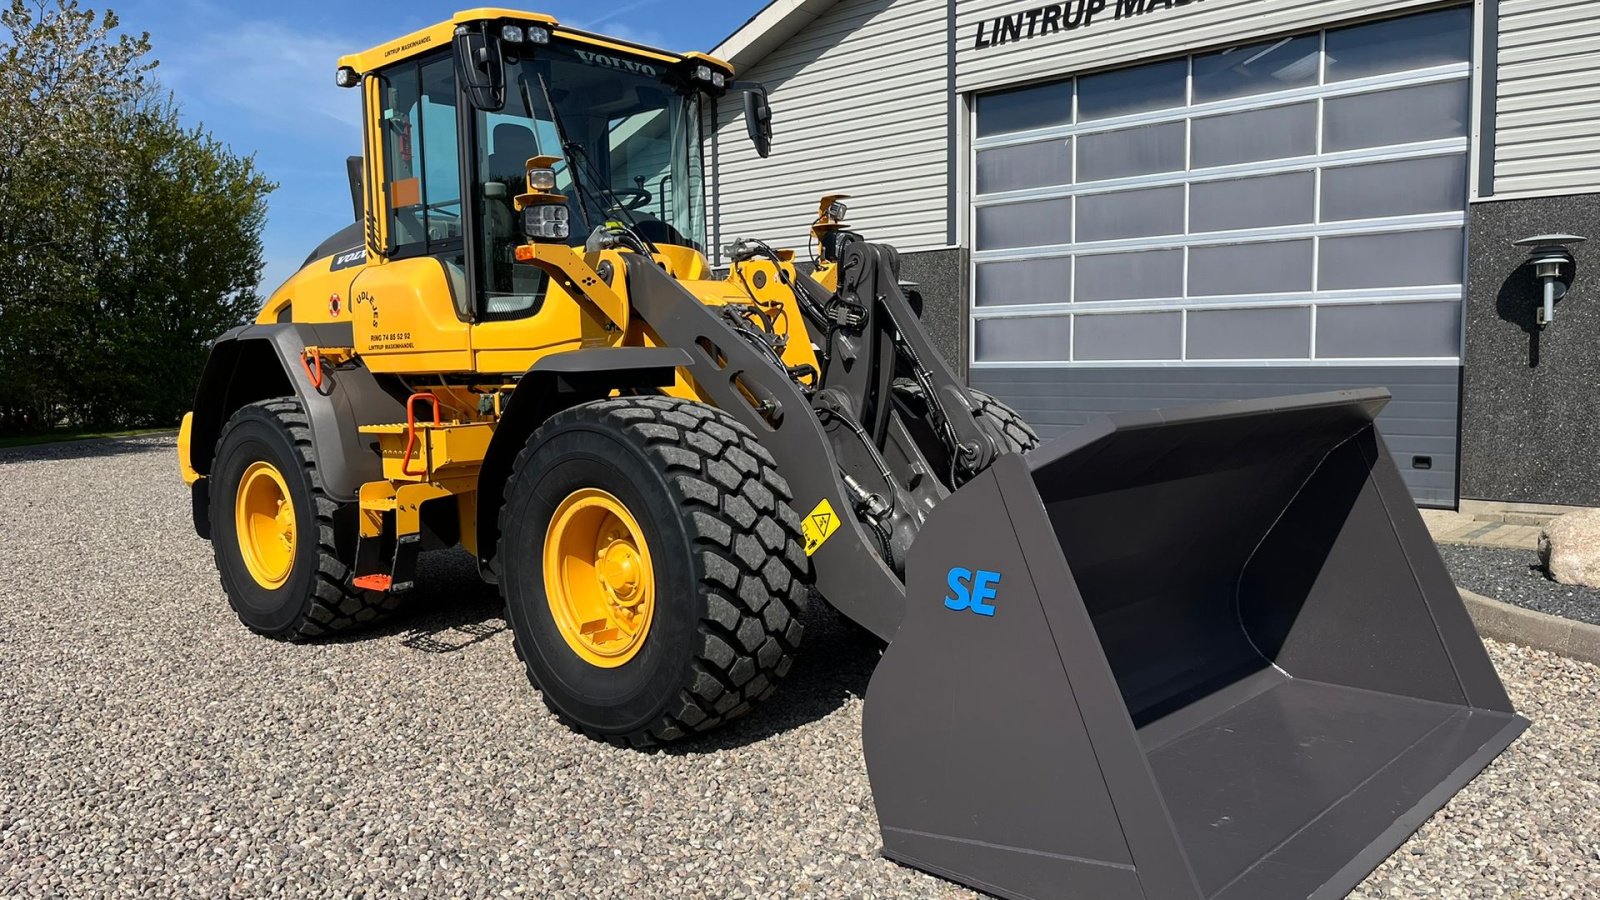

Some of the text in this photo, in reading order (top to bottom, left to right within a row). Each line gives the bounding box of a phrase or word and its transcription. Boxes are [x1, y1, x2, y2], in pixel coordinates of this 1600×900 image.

[975, 0, 1106, 50] LINTRUP
[384, 35, 432, 58] LINTRUP MASKINHANDEL
[573, 48, 657, 77] VOLVO
[356, 291, 379, 328] UDLEJES
[385, 342, 414, 350] MASKINHANDEL
[944, 566, 1002, 617] SE
